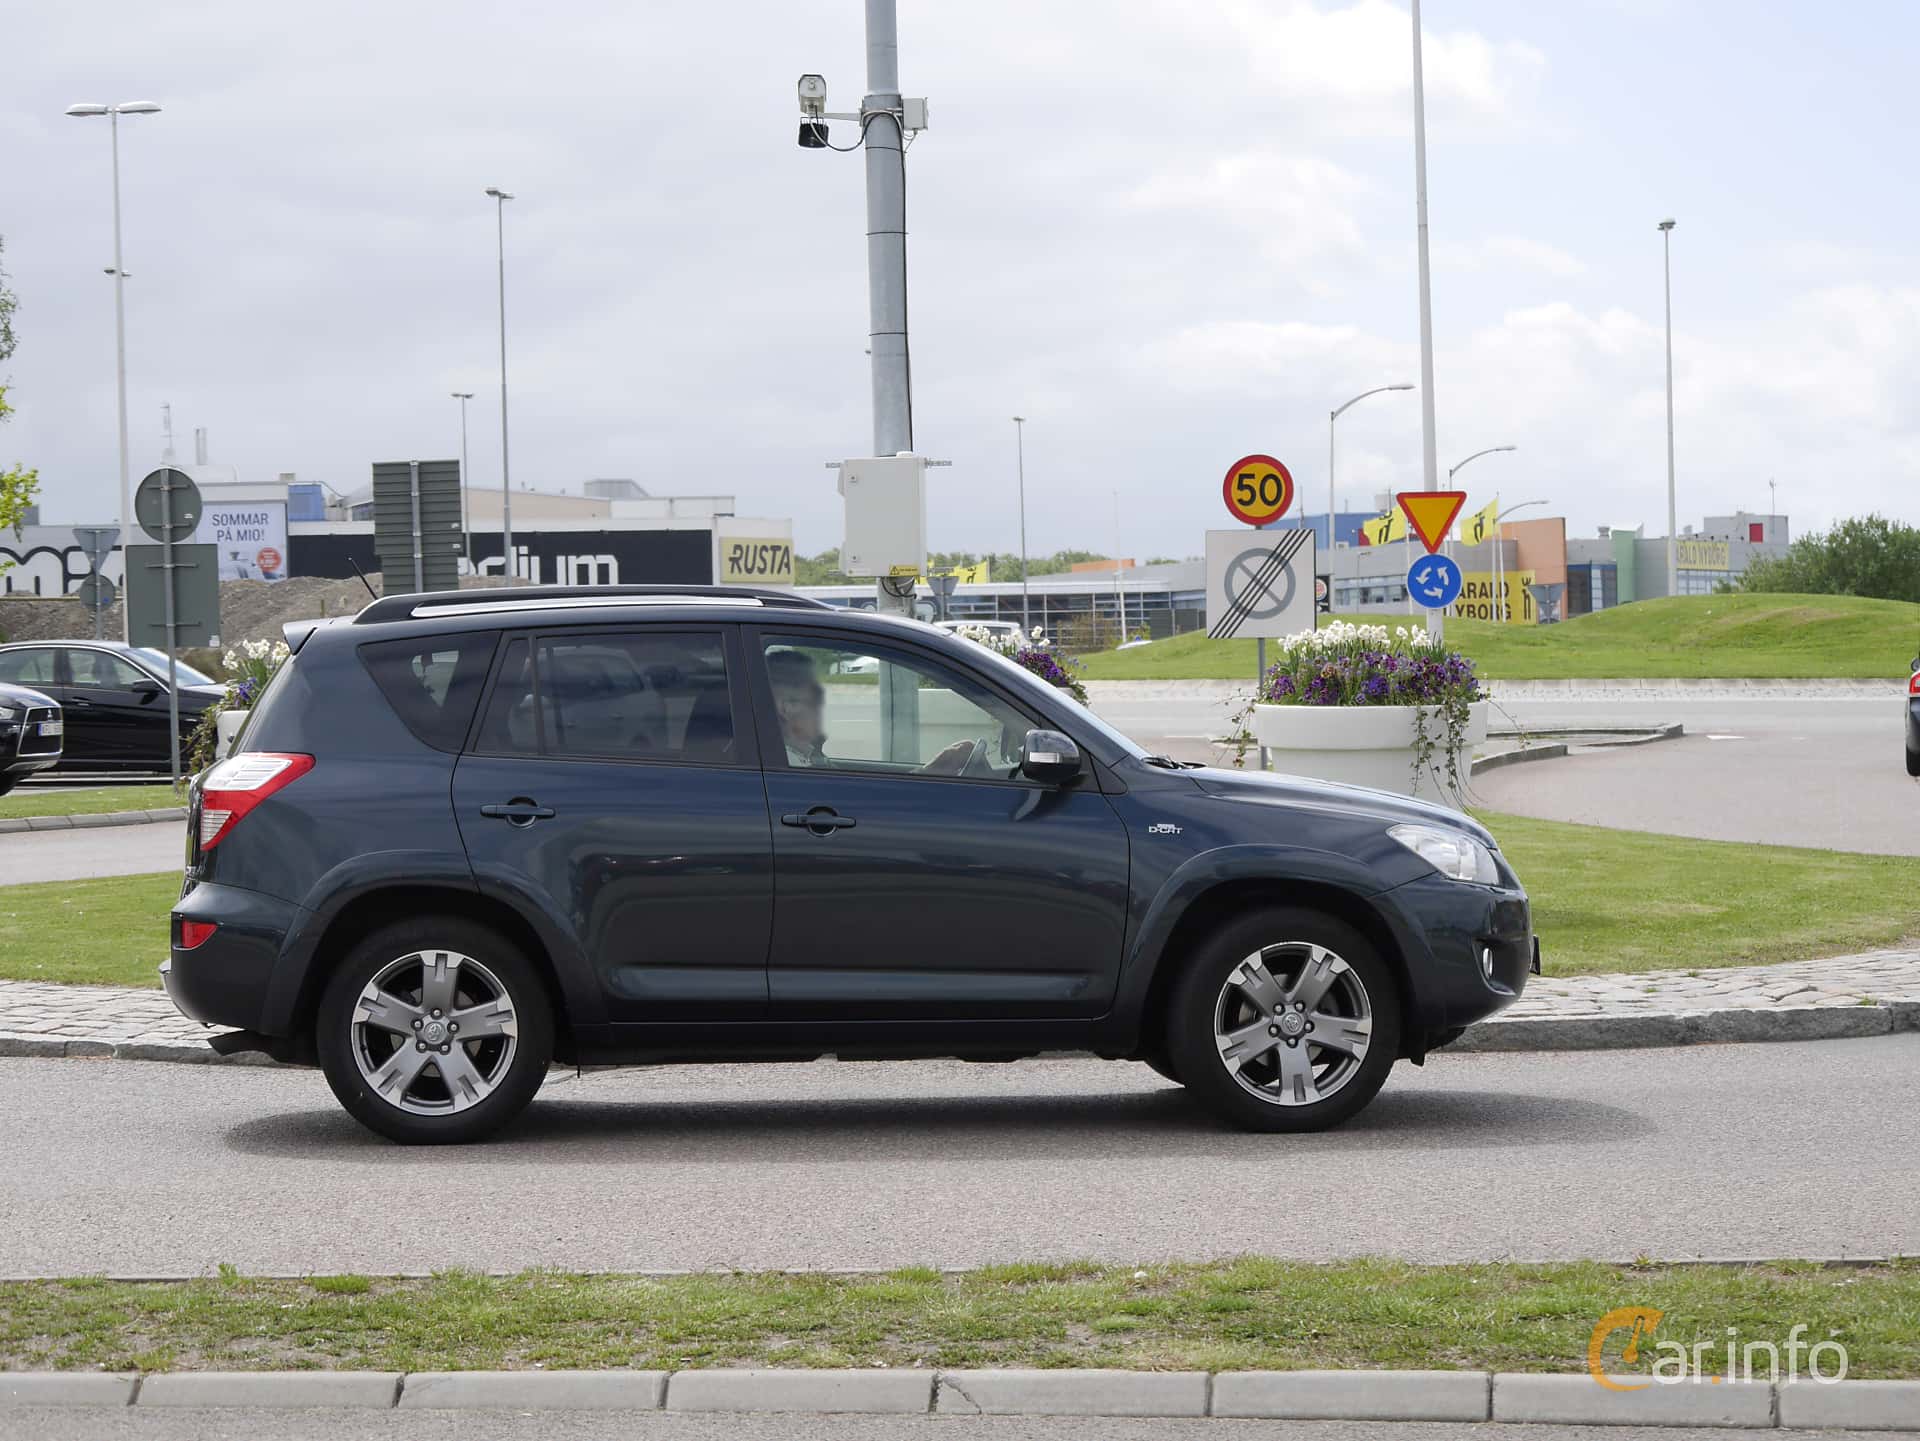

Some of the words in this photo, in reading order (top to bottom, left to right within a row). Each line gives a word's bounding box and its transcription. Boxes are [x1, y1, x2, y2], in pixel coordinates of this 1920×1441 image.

[1237, 473, 1283, 507] 50
[212, 513, 269, 526] SOMMAR
[217, 527, 233, 542] PÅ
[237, 528, 265, 541] MIO!
[728, 544, 791, 575] RUSTA
